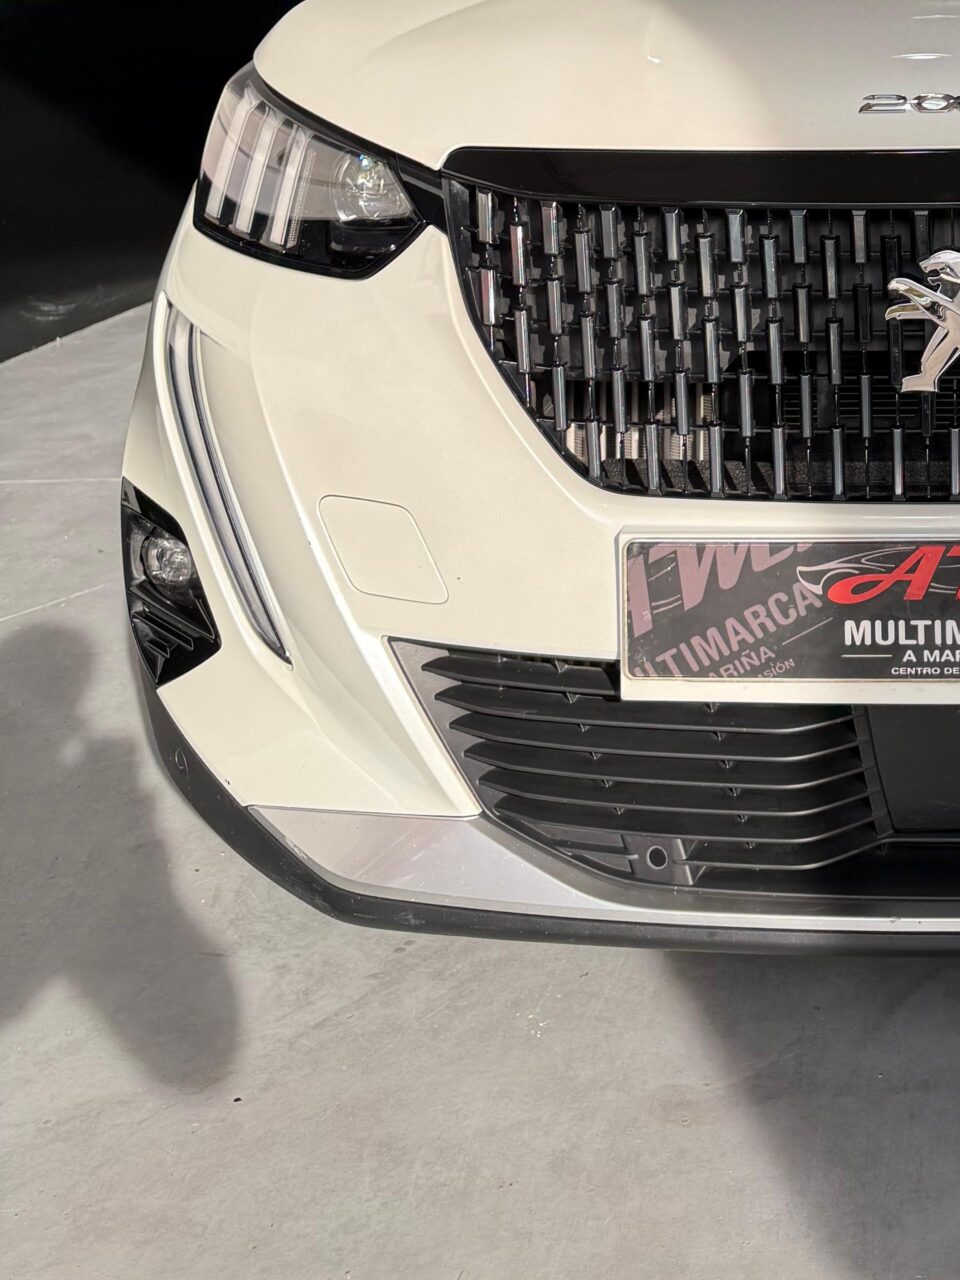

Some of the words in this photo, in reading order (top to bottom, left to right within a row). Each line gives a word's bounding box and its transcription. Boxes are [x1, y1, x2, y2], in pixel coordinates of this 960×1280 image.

[902, 650, 917, 662] A
[891, 666, 941, 675] CENTRO
[944, 666, 960, 675] DE
